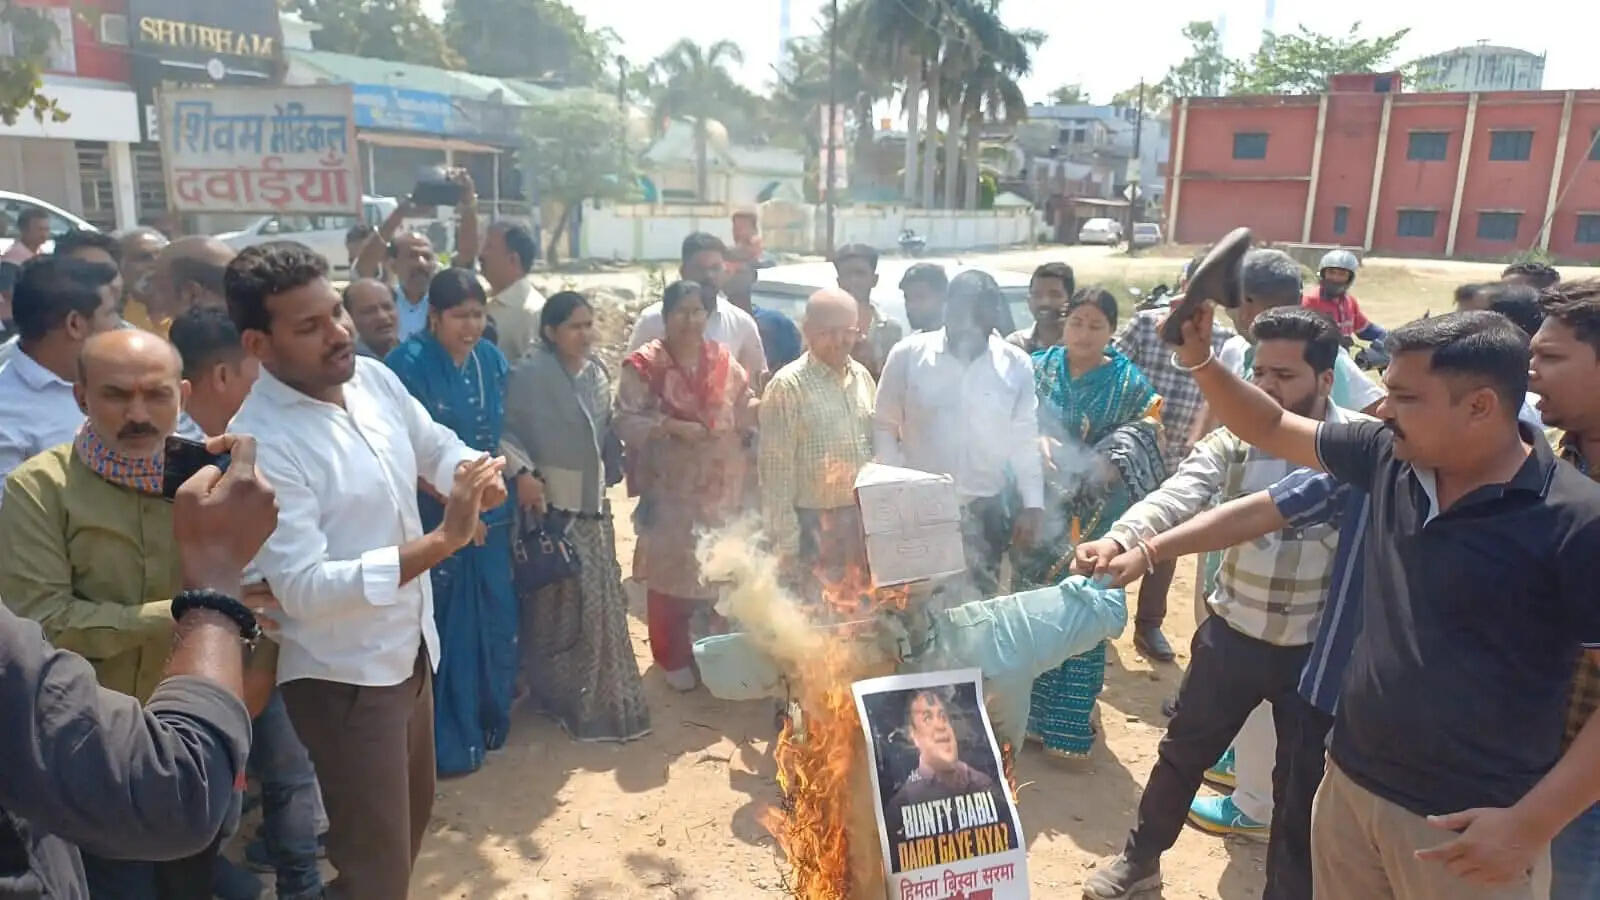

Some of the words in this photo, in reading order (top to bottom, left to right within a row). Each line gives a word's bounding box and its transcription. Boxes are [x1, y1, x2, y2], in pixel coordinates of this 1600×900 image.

[139, 16, 274, 56] SHUBHAM
[173, 101, 265, 154] शिवम
[174, 150, 350, 210] दवाईयाँ
[901, 797, 954, 840] BUNTY
[955, 790, 999, 829] BABLI
[898, 836, 937, 872] DARR
[937, 830, 975, 865] GAYE
[974, 823, 1010, 857] KYA?
[943, 868, 979, 895] बिस्वा
[981, 863, 1015, 885] सरमा
